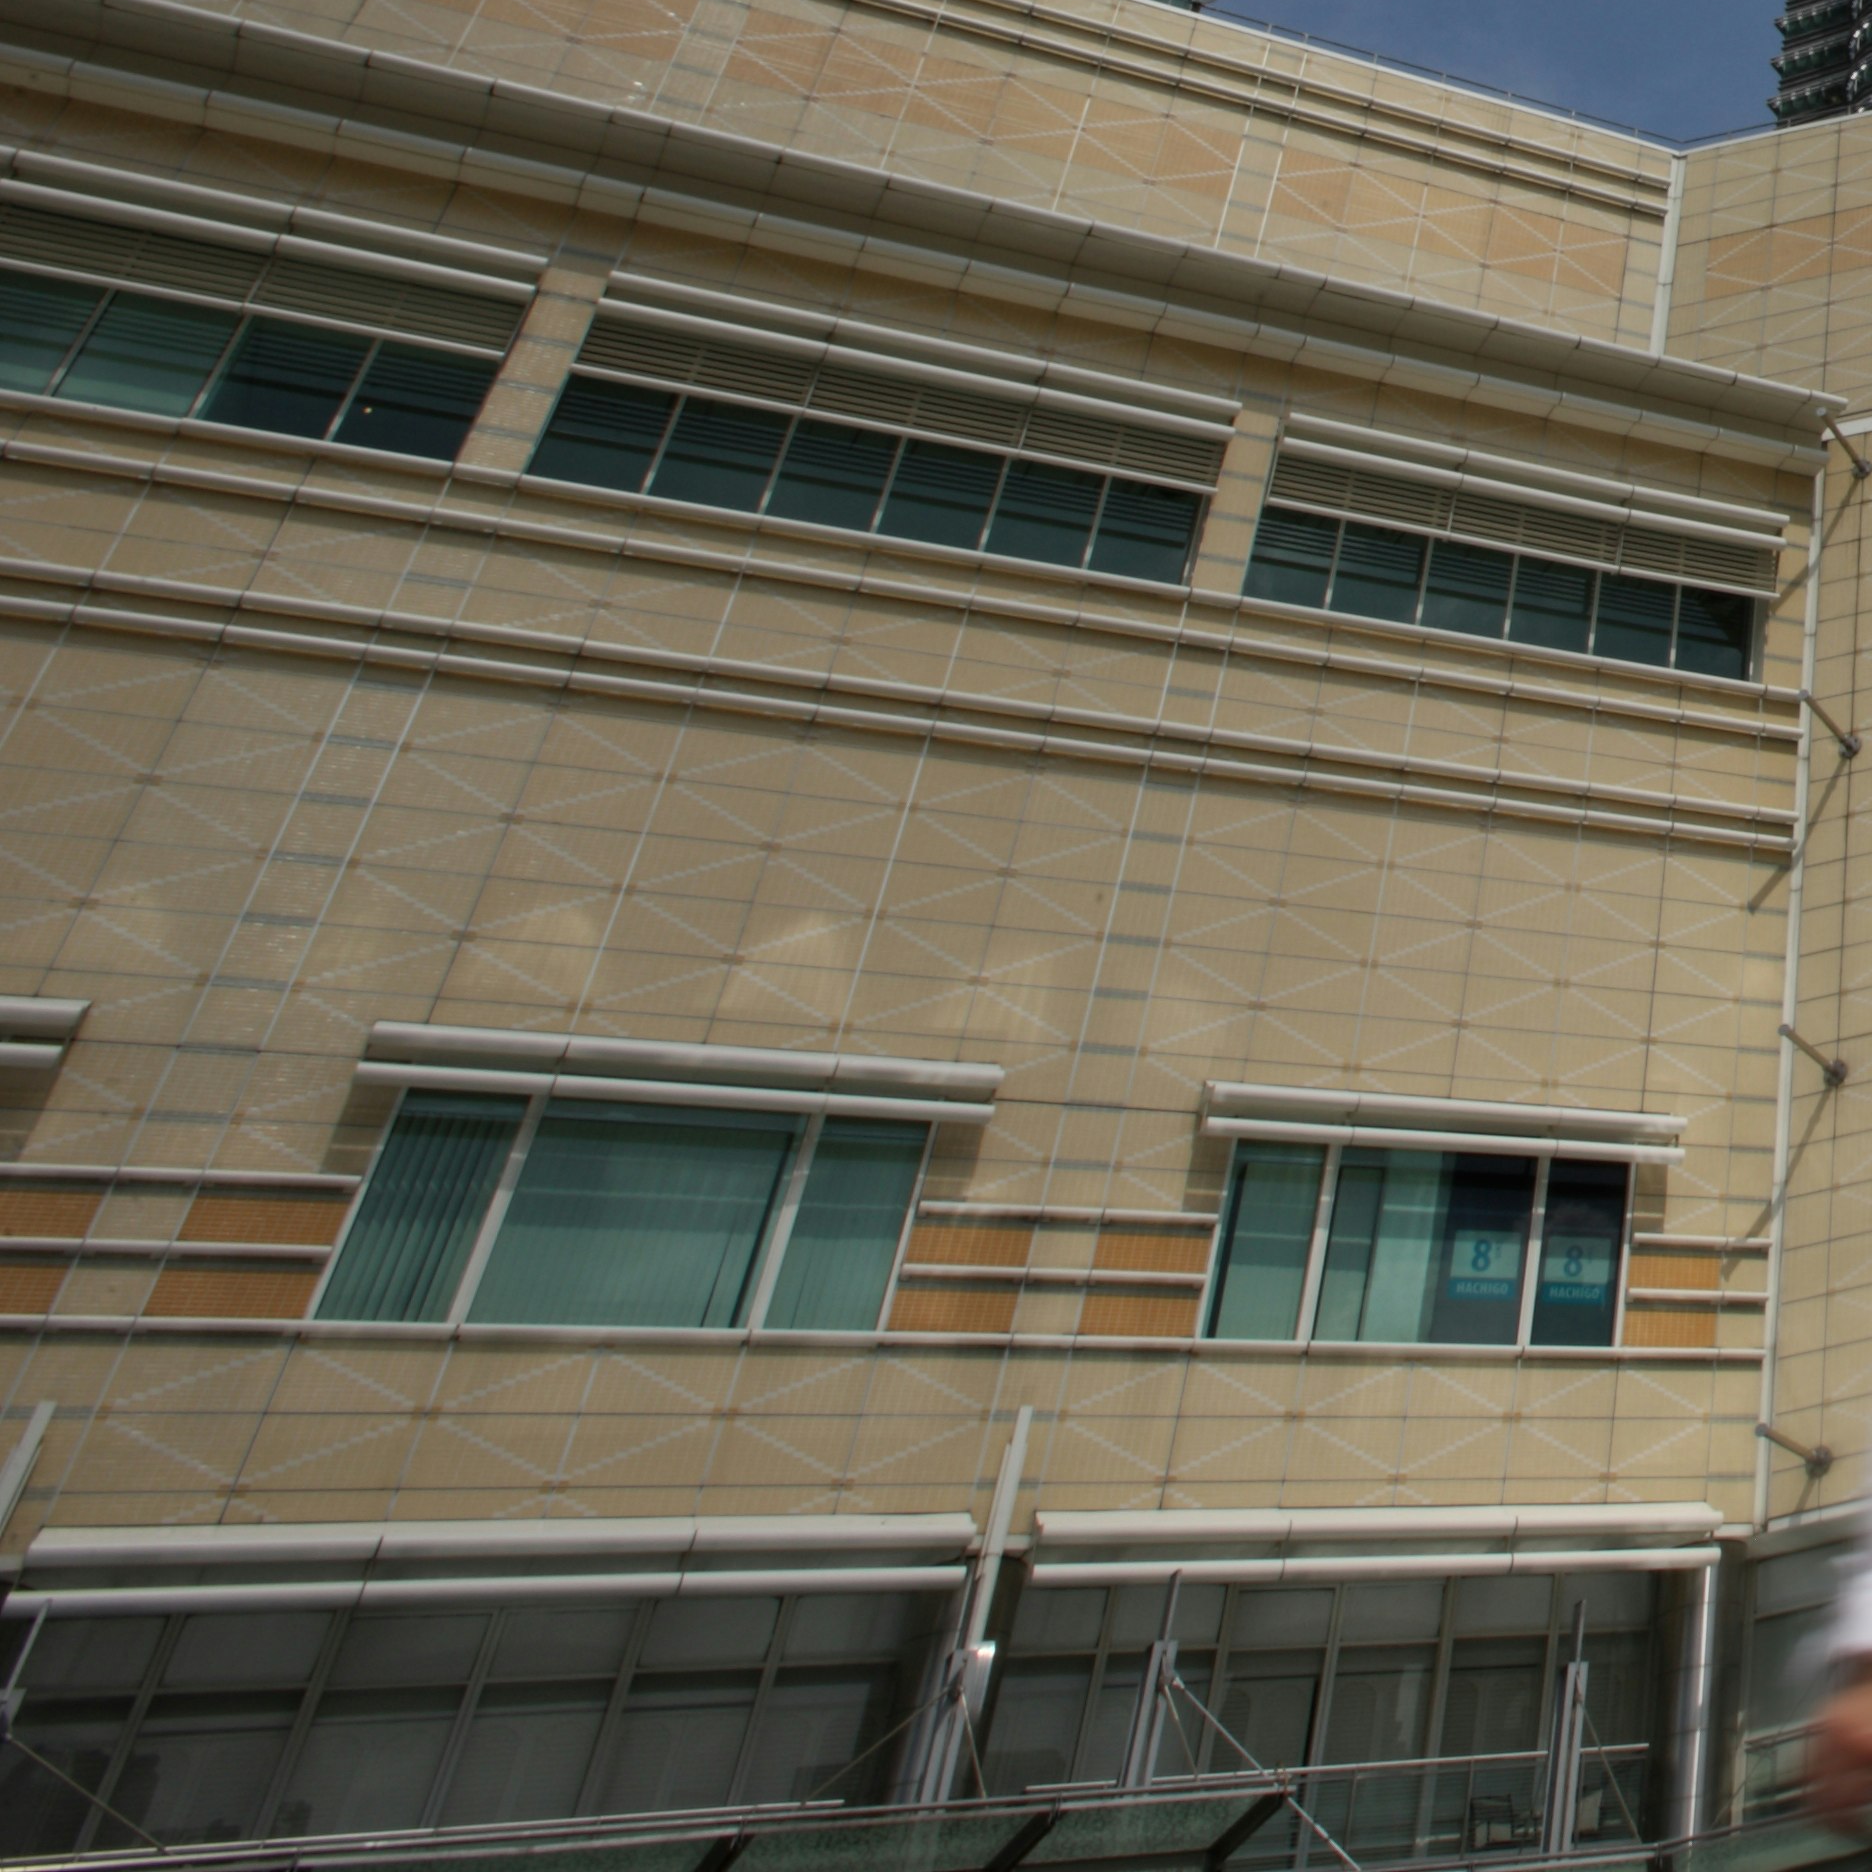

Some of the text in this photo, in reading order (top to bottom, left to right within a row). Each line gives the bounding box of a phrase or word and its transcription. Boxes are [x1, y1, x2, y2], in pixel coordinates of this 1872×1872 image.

[1471, 1238, 1493, 1272] 8
[1564, 1245, 1585, 1277] 8
[1456, 1281, 1508, 1296] HACHIGO
[1549, 1286, 1600, 1301] HACHIGO
